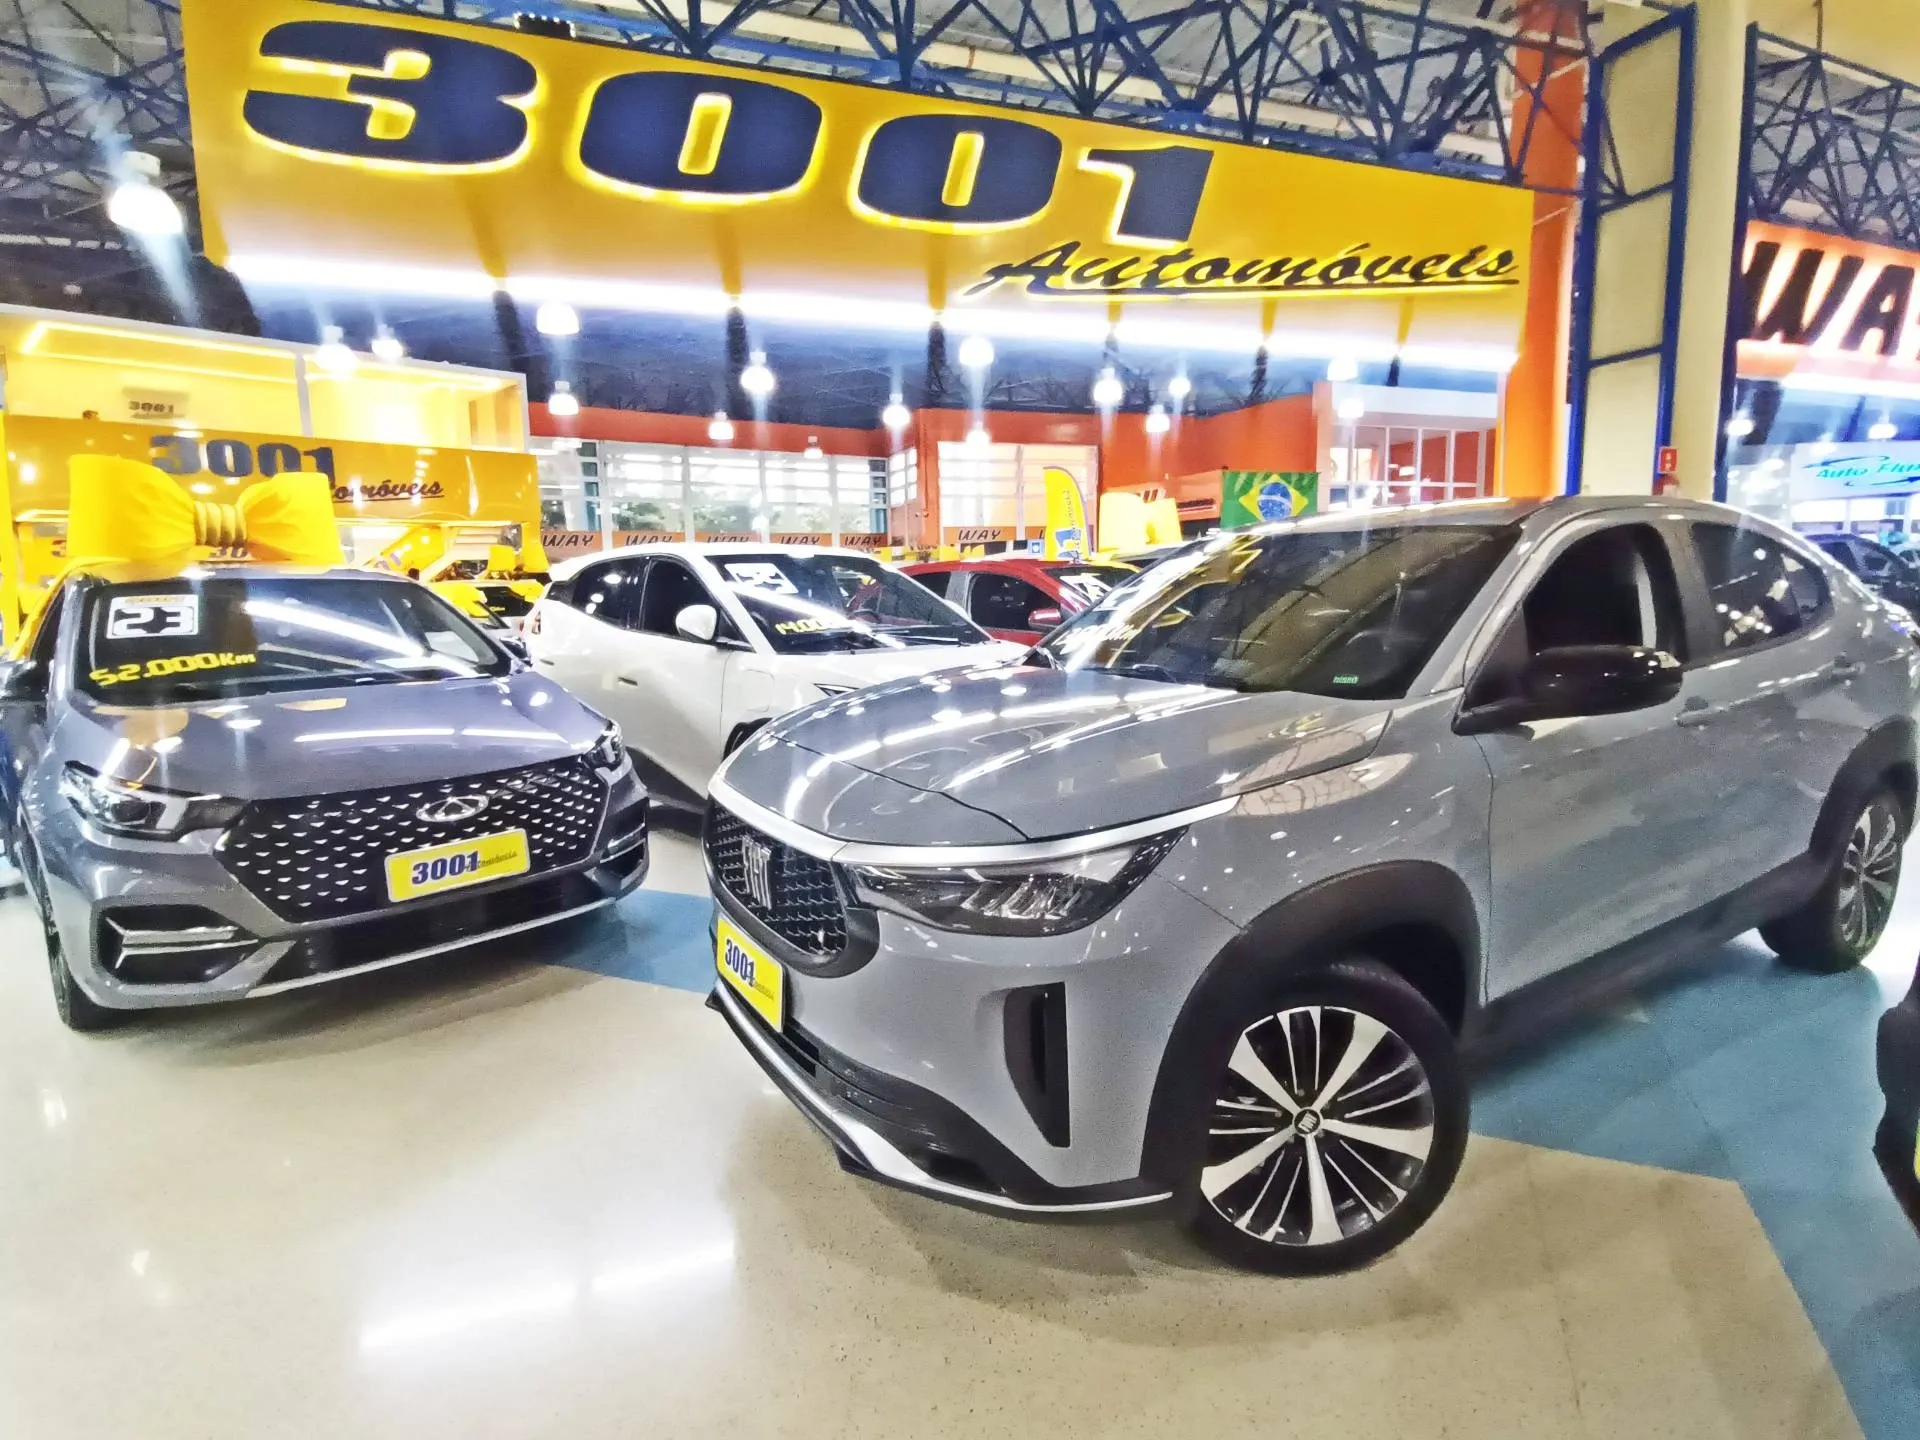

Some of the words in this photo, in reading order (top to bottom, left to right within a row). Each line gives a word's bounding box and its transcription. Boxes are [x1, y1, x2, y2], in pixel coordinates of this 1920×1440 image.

[243, 20, 1215, 243] 3001
[962, 241, 1520, 296] Automóveis
[1738, 240, 1920, 357] WA
[150, 434, 335, 490] 3001
[1816, 466, 1868, 479] Auto
[543, 534, 594, 547] WAY
[780, 534, 821, 545] WAY
[844, 534, 882, 546] WAY
[957, 529, 1001, 541] WAY
[113, 606, 195, 635] 23
[89, 652, 257, 686] 52.000Km
[411, 850, 480, 885] 3001
[725, 938, 755, 988] 3001
